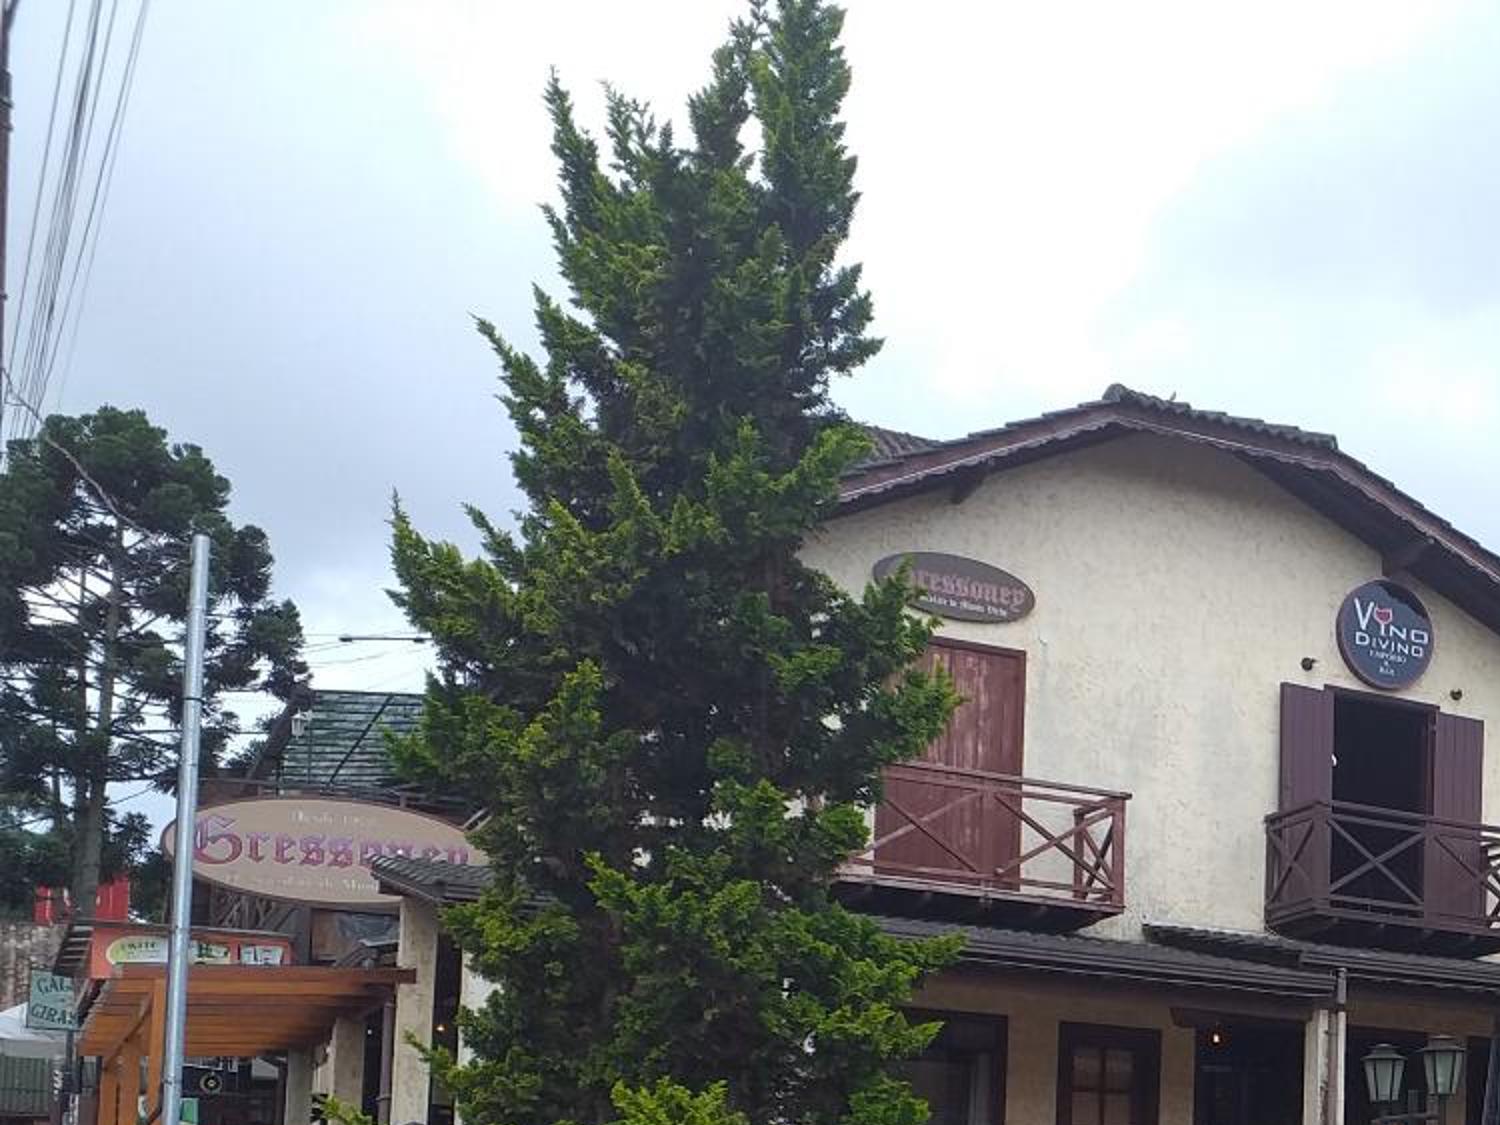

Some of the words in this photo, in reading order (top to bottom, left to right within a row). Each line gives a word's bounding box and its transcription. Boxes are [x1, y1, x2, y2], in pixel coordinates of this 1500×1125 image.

[909, 568, 1025, 613] ressoney
[1354, 598, 1428, 644] VINO
[1355, 631, 1423, 657] DIVINO
